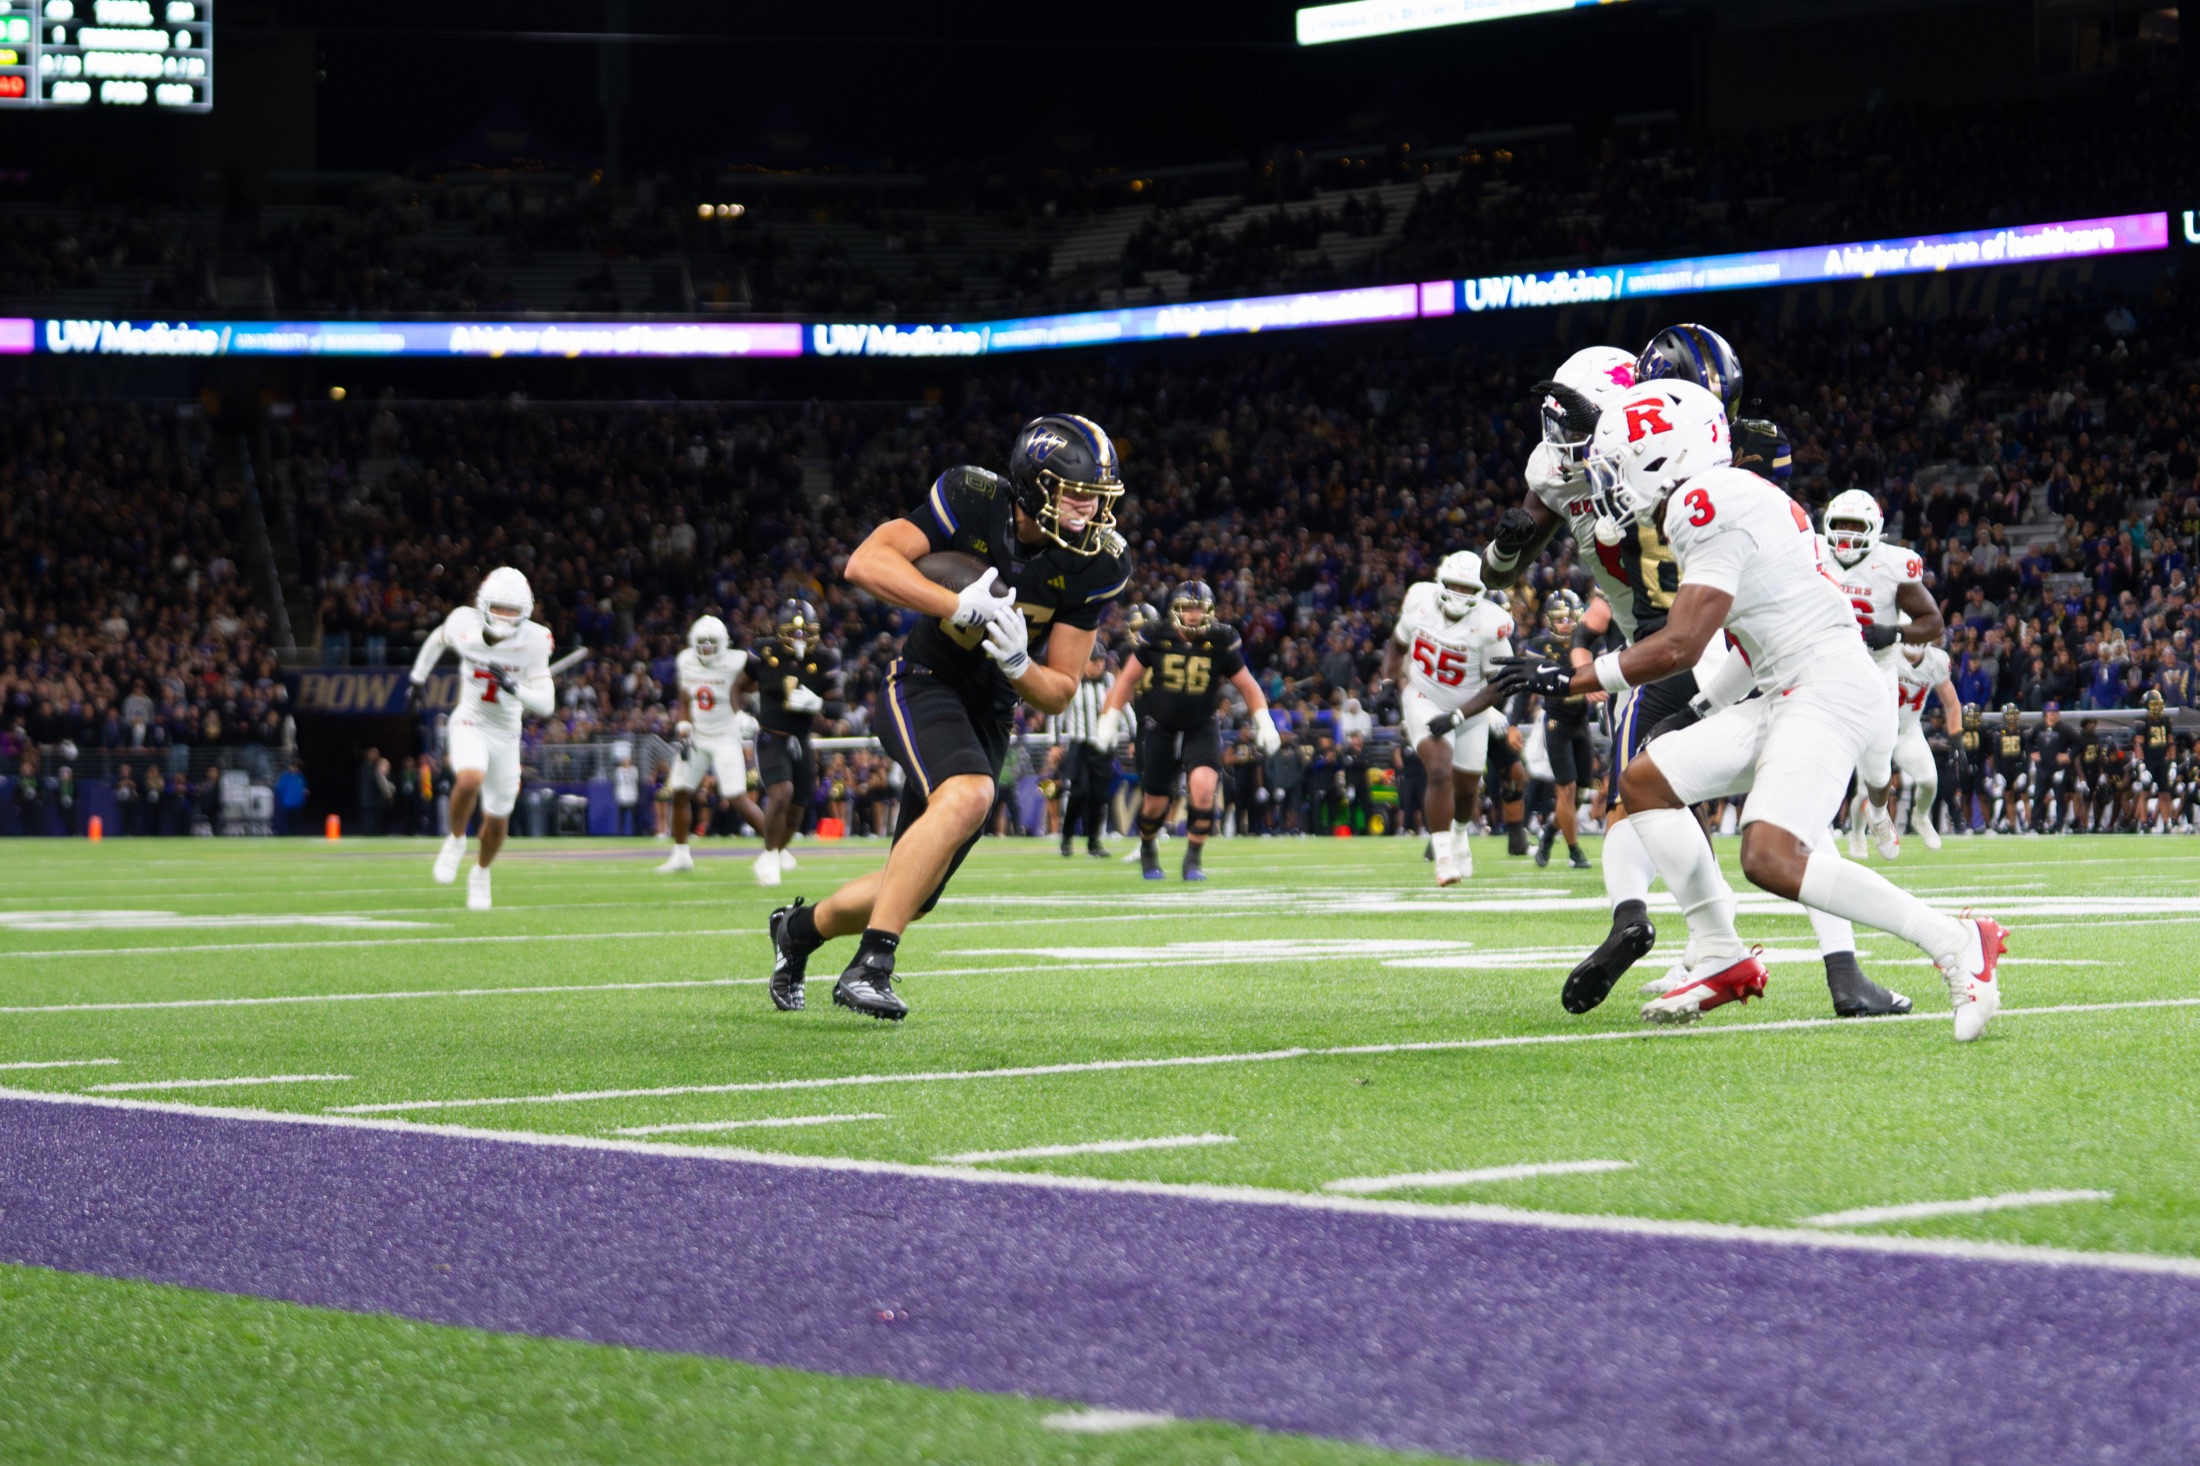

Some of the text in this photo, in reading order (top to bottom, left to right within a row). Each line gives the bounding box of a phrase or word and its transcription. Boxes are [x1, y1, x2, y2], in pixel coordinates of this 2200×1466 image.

[1843, 244, 1909, 277] higher
[1909, 240, 1980, 271] degree
[1464, 269, 1614, 312] UW Medicine
[46, 319, 220, 356] UW Medicine
[813, 324, 982, 356] UW Medicine
[1623, 397, 1673, 443] R
[1026, 425, 1068, 463] W
[1684, 488, 1716, 527] 3
[1163, 653, 1212, 694] 56
[1412, 637, 1468, 687] 55
[298, 673, 400, 710] BOW
[473, 667, 500, 704] 7
